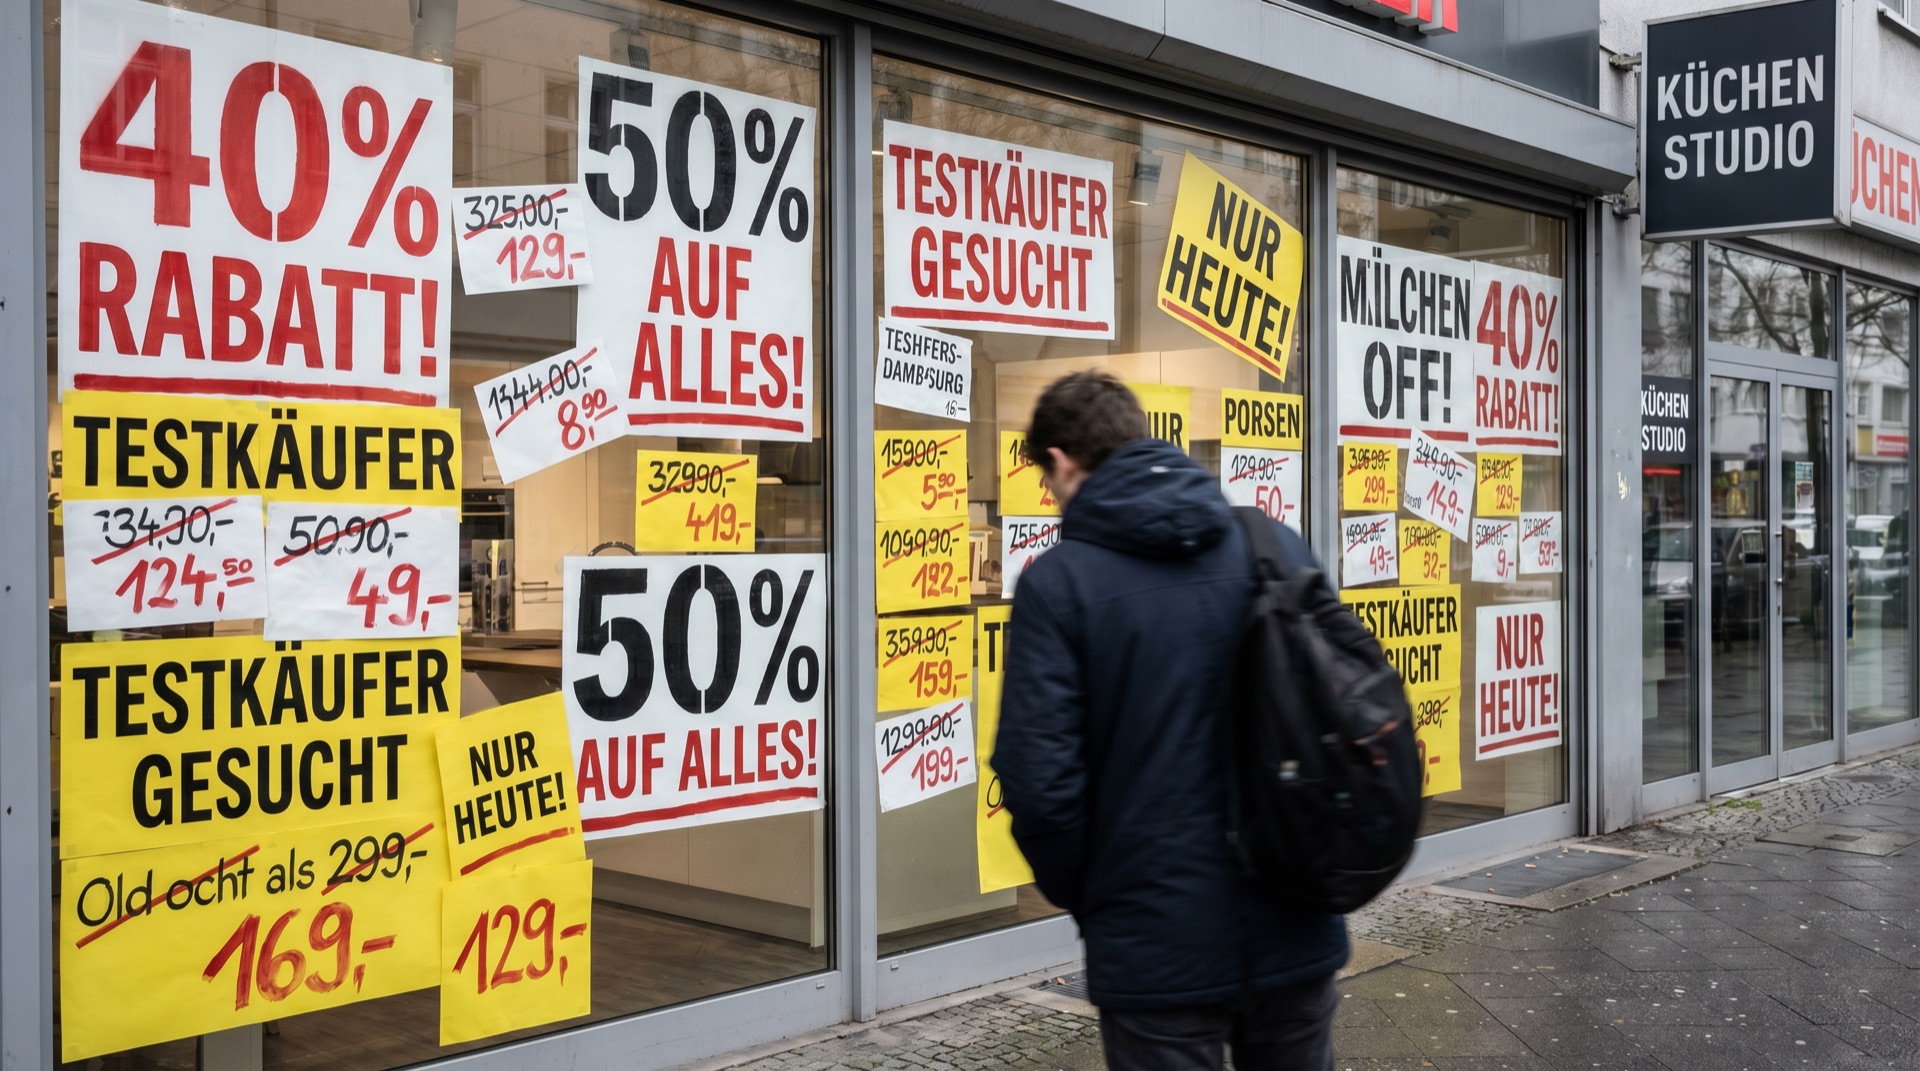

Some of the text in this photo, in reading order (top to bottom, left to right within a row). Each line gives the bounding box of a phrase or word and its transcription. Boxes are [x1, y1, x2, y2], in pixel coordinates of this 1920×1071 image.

[1657, 54, 1824, 122] KÜCHEN
[80, 41, 438, 257] 40%
[585, 72, 809, 243] 50%
[1664, 119, 1814, 181] STUDIO
[889, 144, 1109, 239] TESTKÄUFER
[1206, 181, 1281, 281] NUR
[496, 232, 586, 284] 129,-
[648, 236, 752, 320] AUF
[911, 226, 1093, 312] GESUCHT
[1165, 235, 1291, 363] HEUTE!
[79, 241, 438, 377] RABATT!
[1477, 280, 1559, 373] 40%
[629, 322, 804, 410] ALLES!
[1363, 341, 1452, 424] OFF!
[1476, 375, 1559, 434] RABATT!
[1641, 385, 1689, 419] KÜCHEN
[73, 409, 456, 491] TESTKÄUFER
[1225, 398, 1300, 438] PORSEN
[1641, 429, 1686, 457] STUDIO
[685, 501, 752, 545] 419,-
[1363, 475, 1395, 506] 299,-
[347, 563, 453, 631] 49,-
[573, 564, 820, 722] 50%
[909, 659, 967, 699] 159,-
[1496, 612, 1545, 671] NUR
[73, 640, 449, 740] TESTKÄUFER
[1480, 672, 1559, 738] HEUTE!
[131, 734, 408, 829] GESUCHT
[468, 730, 538, 787] NUR
[577, 718, 818, 804] AUF ALLES!
[911, 746, 968, 791] 199,-
[453, 772, 567, 845] HEUTE!
[77, 832, 429, 926] Old ocht als 299,-
[202, 902, 397, 1011] 169,-
[452, 898, 588, 995] 129,-
